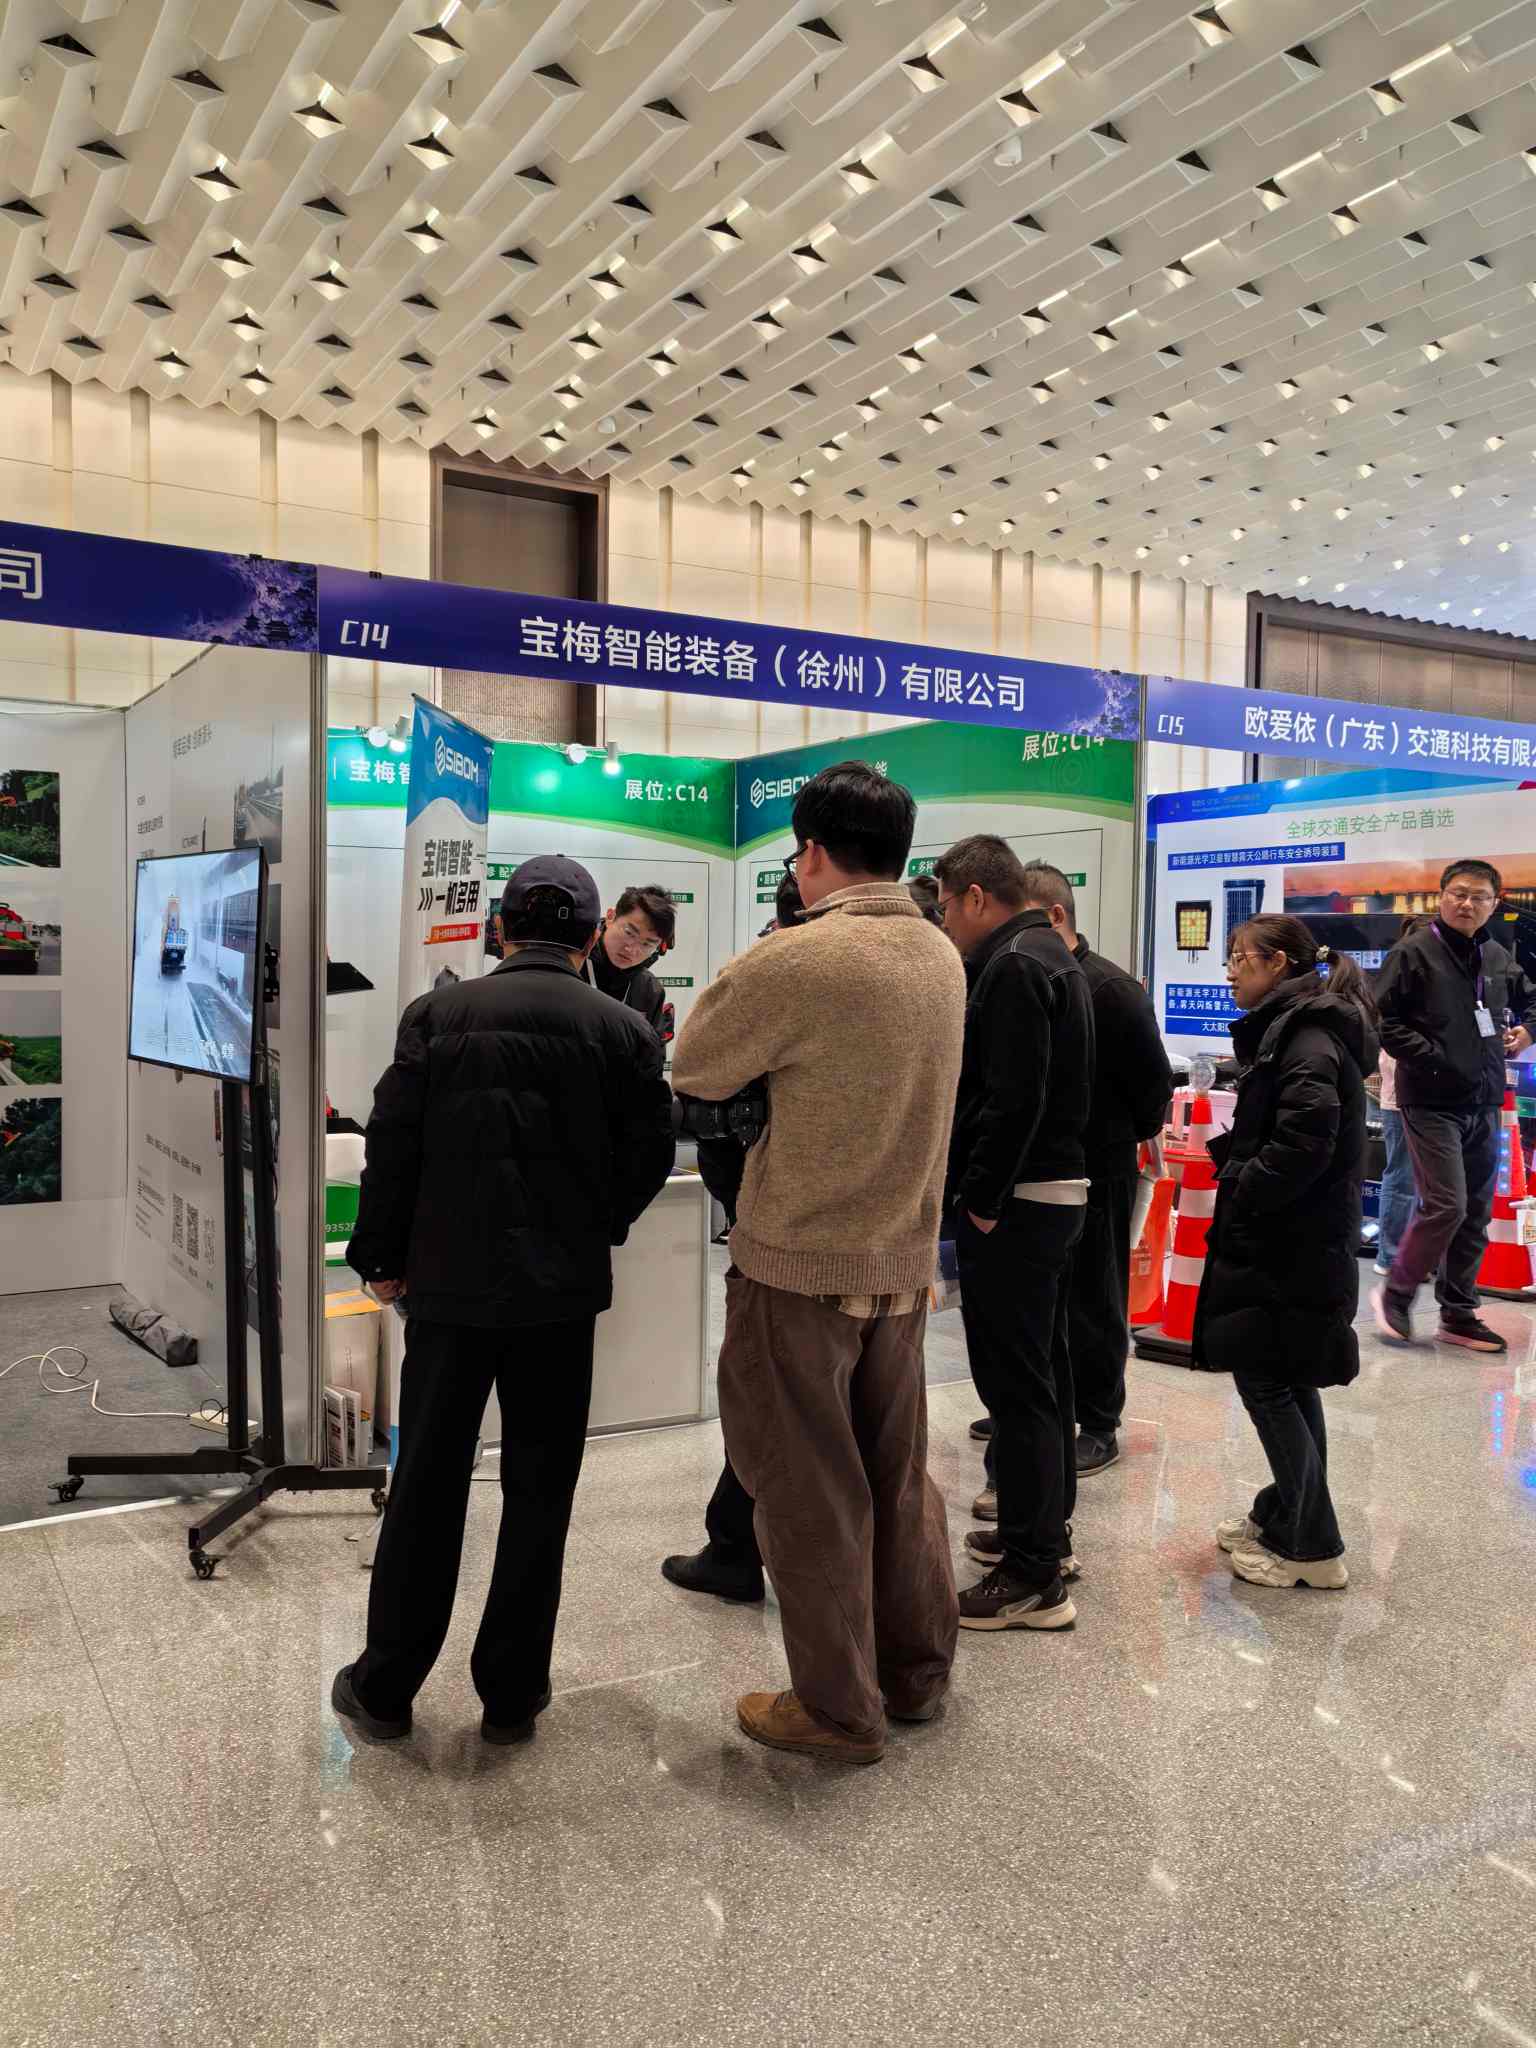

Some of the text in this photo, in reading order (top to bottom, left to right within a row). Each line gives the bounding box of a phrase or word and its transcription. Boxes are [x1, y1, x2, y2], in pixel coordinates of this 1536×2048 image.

[340, 619, 390, 649] C14
[519, 616, 1025, 713] 宝梅智能装备（徐州）有限公司
[1158, 714, 1184, 737] C15
[1244, 705, 1536, 768] 欧爱依（广东）交通科技有限
[445, 747, 480, 784] SIBOM
[765, 774, 812, 800] SIBO
[1286, 808, 1456, 840] 全球交通安全产品首选
